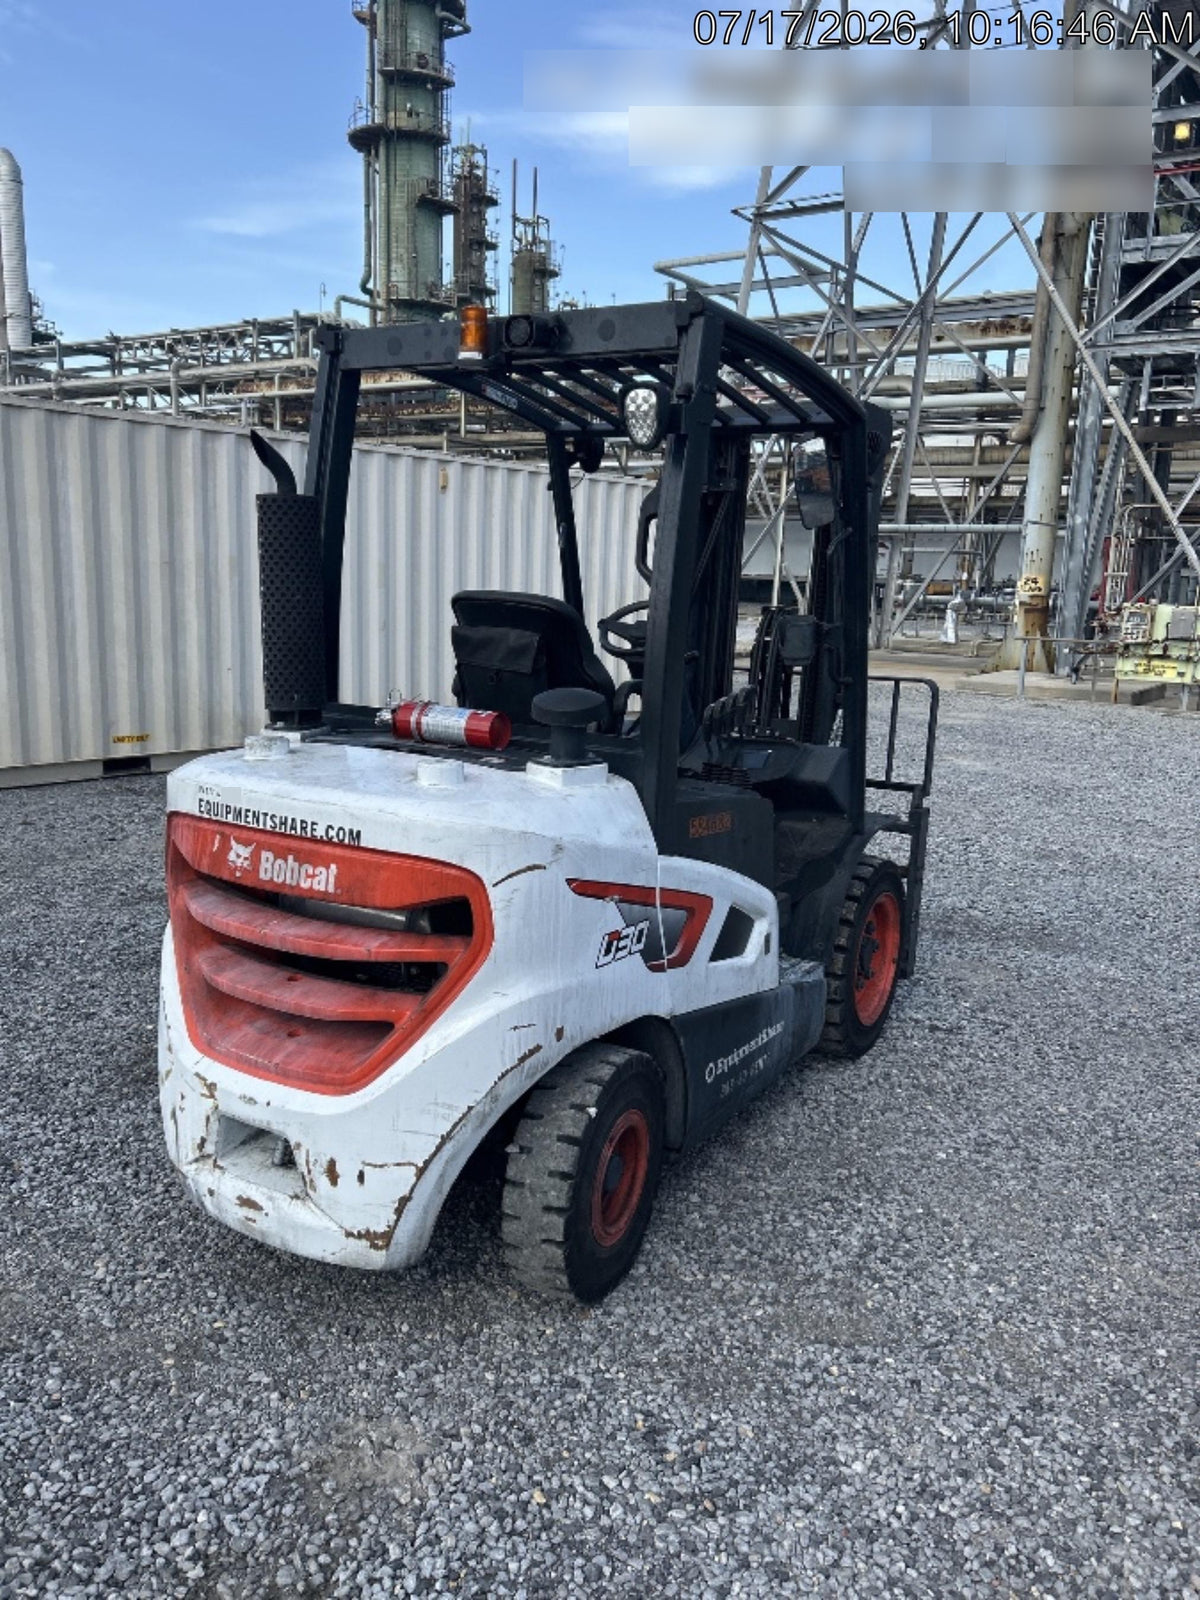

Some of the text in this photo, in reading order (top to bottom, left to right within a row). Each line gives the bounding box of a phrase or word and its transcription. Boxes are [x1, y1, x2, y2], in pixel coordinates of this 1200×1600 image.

[198, 798, 362, 846] EQUIPMENTSHARE.COM
[259, 850, 338, 894] Bobcat
[595, 919, 650, 969] D30
